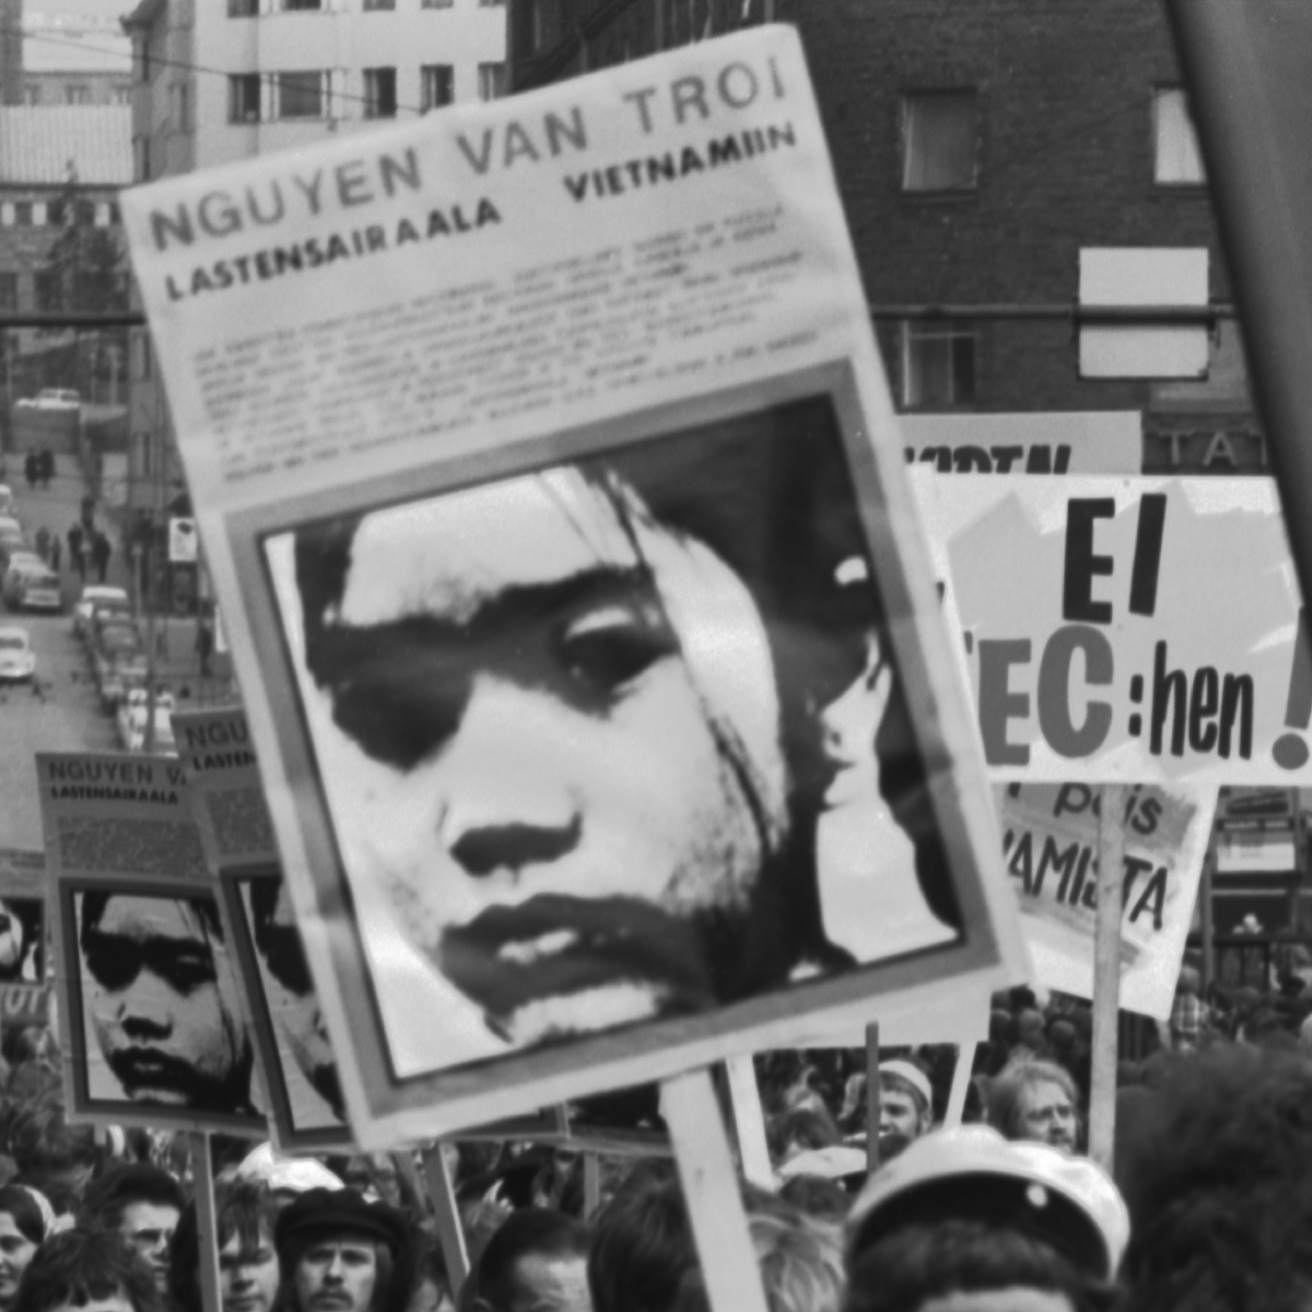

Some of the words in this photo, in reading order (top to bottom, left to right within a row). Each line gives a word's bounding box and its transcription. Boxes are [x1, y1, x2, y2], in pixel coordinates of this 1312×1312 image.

[148, 147, 421, 253] NGUYEN
[456, 105, 589, 177] VAN
[622, 55, 787, 136] TROI
[164, 197, 502, 302] LASTENSAIRAALA
[563, 121, 797, 203] VIETNAMIIN
[1062, 492, 1168, 625] EI
[48, 760, 154, 784] NGUYEN
[50, 785, 179, 805] LASTENSAIRAALA
